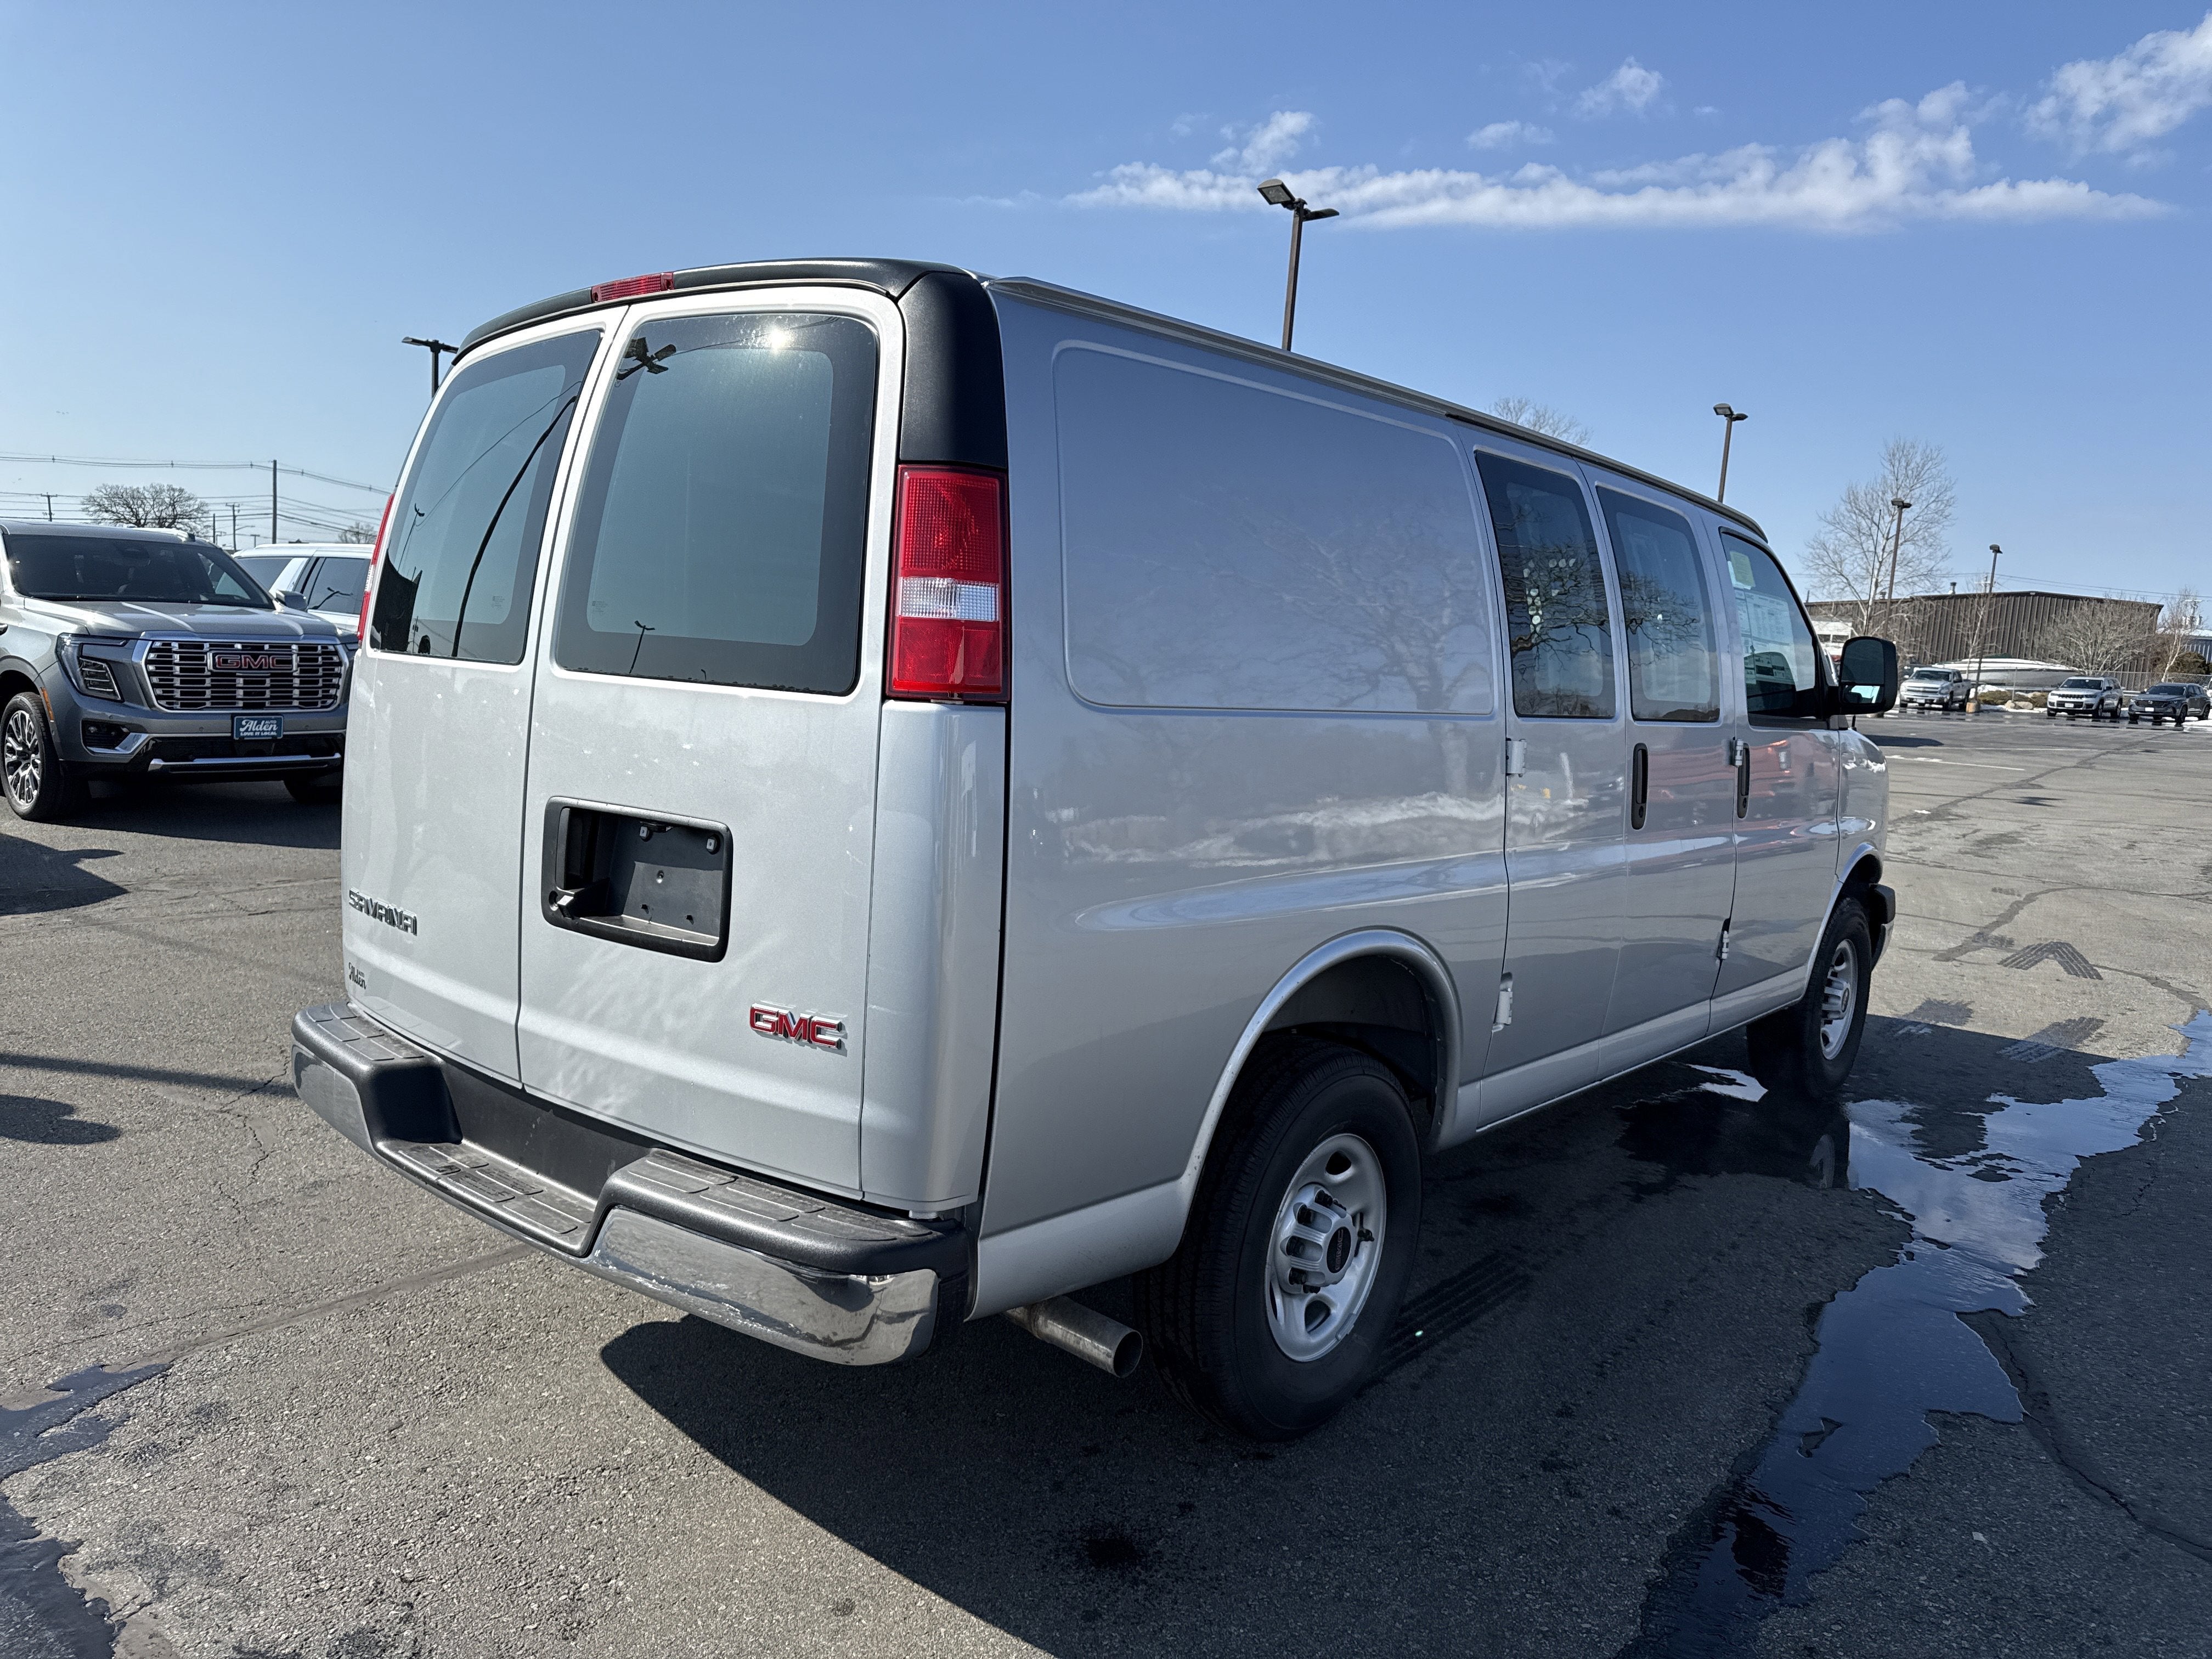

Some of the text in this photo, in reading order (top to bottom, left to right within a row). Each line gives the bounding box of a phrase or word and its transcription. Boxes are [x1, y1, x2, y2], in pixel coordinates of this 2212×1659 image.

[215, 654, 292, 669] GMC
[239, 719, 278, 731] Alden
[348, 887, 417, 936] SAVANA
[348, 962, 367, 990] Alden
[749, 1003, 843, 1050] GMC
[1335, 1229, 1344, 1271] GMC
